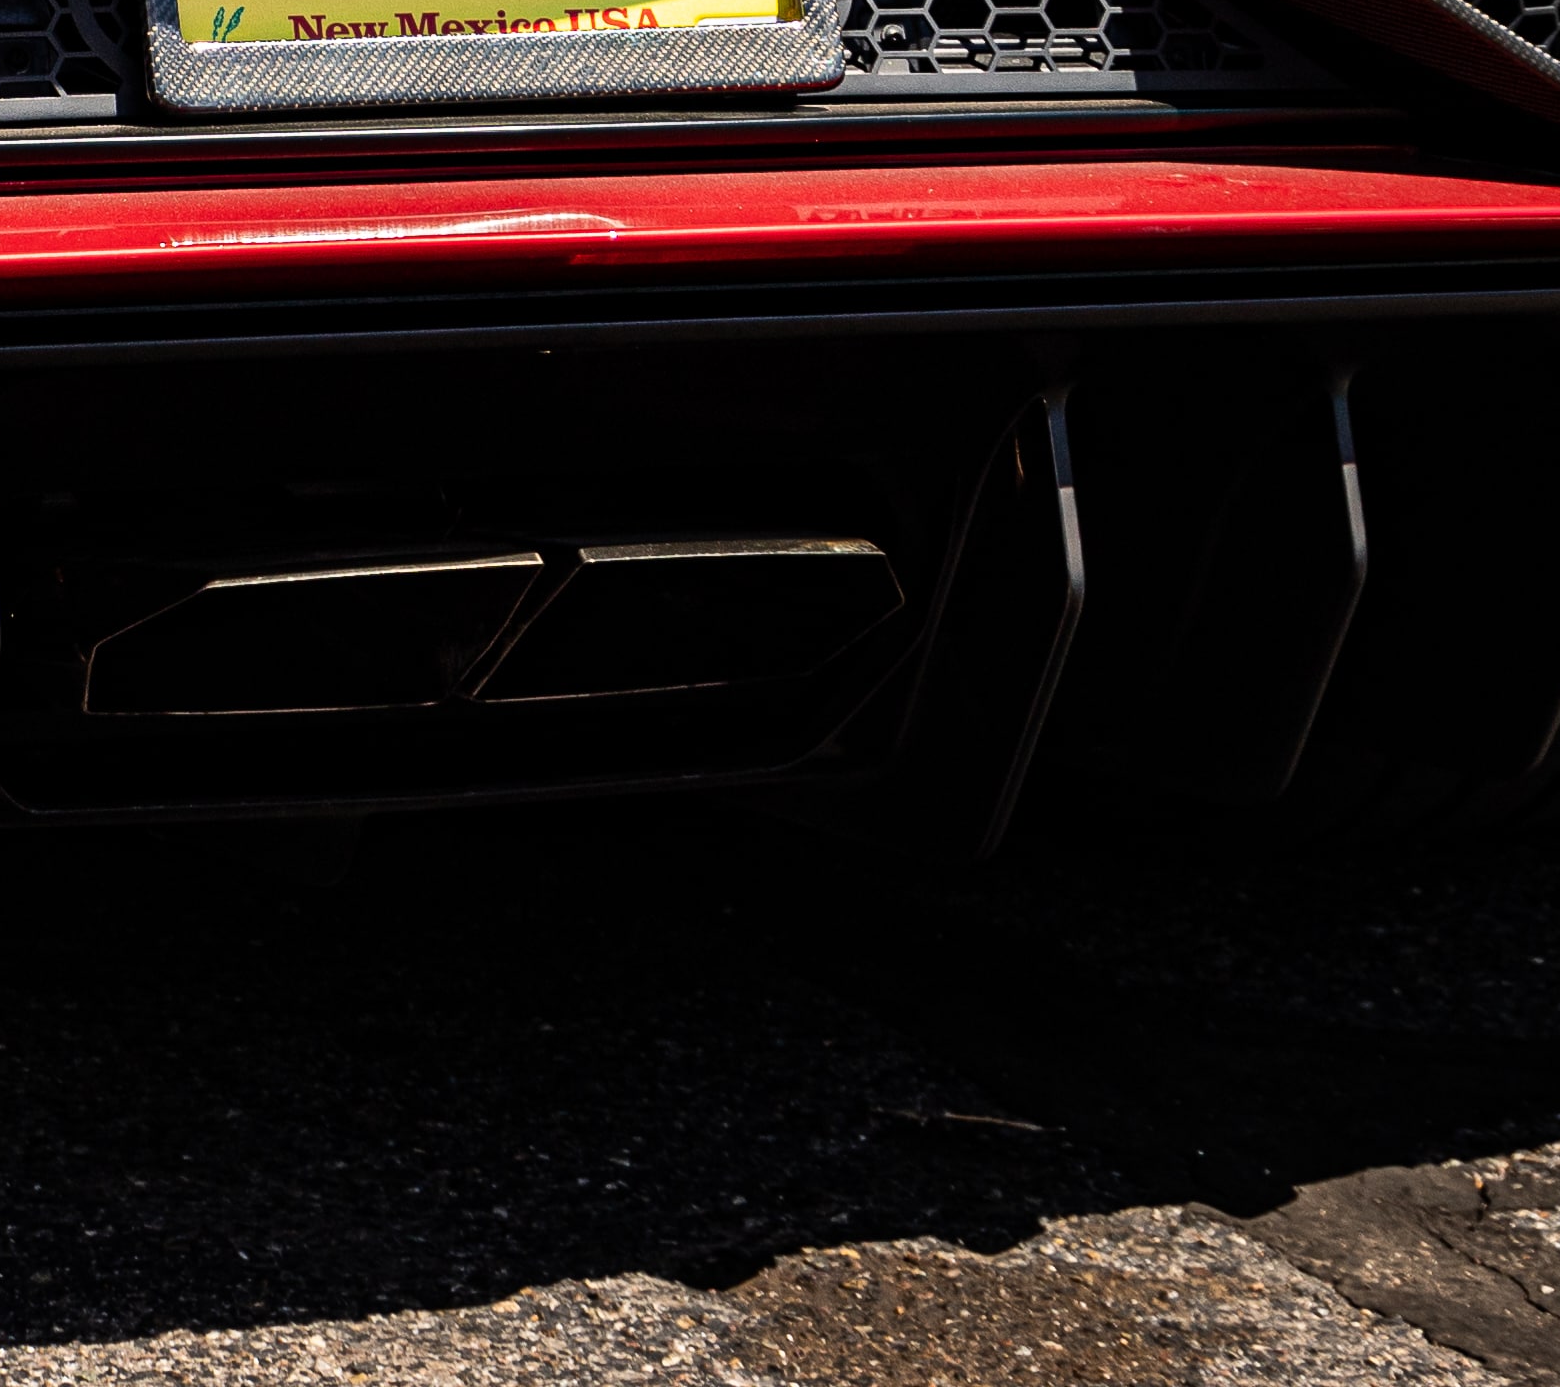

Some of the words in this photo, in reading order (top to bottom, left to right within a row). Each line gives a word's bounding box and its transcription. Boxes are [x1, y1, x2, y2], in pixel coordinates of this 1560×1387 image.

[288, 14, 389, 41] New
[394, 10, 558, 39] Mexico
[564, 6, 661, 33] USA
